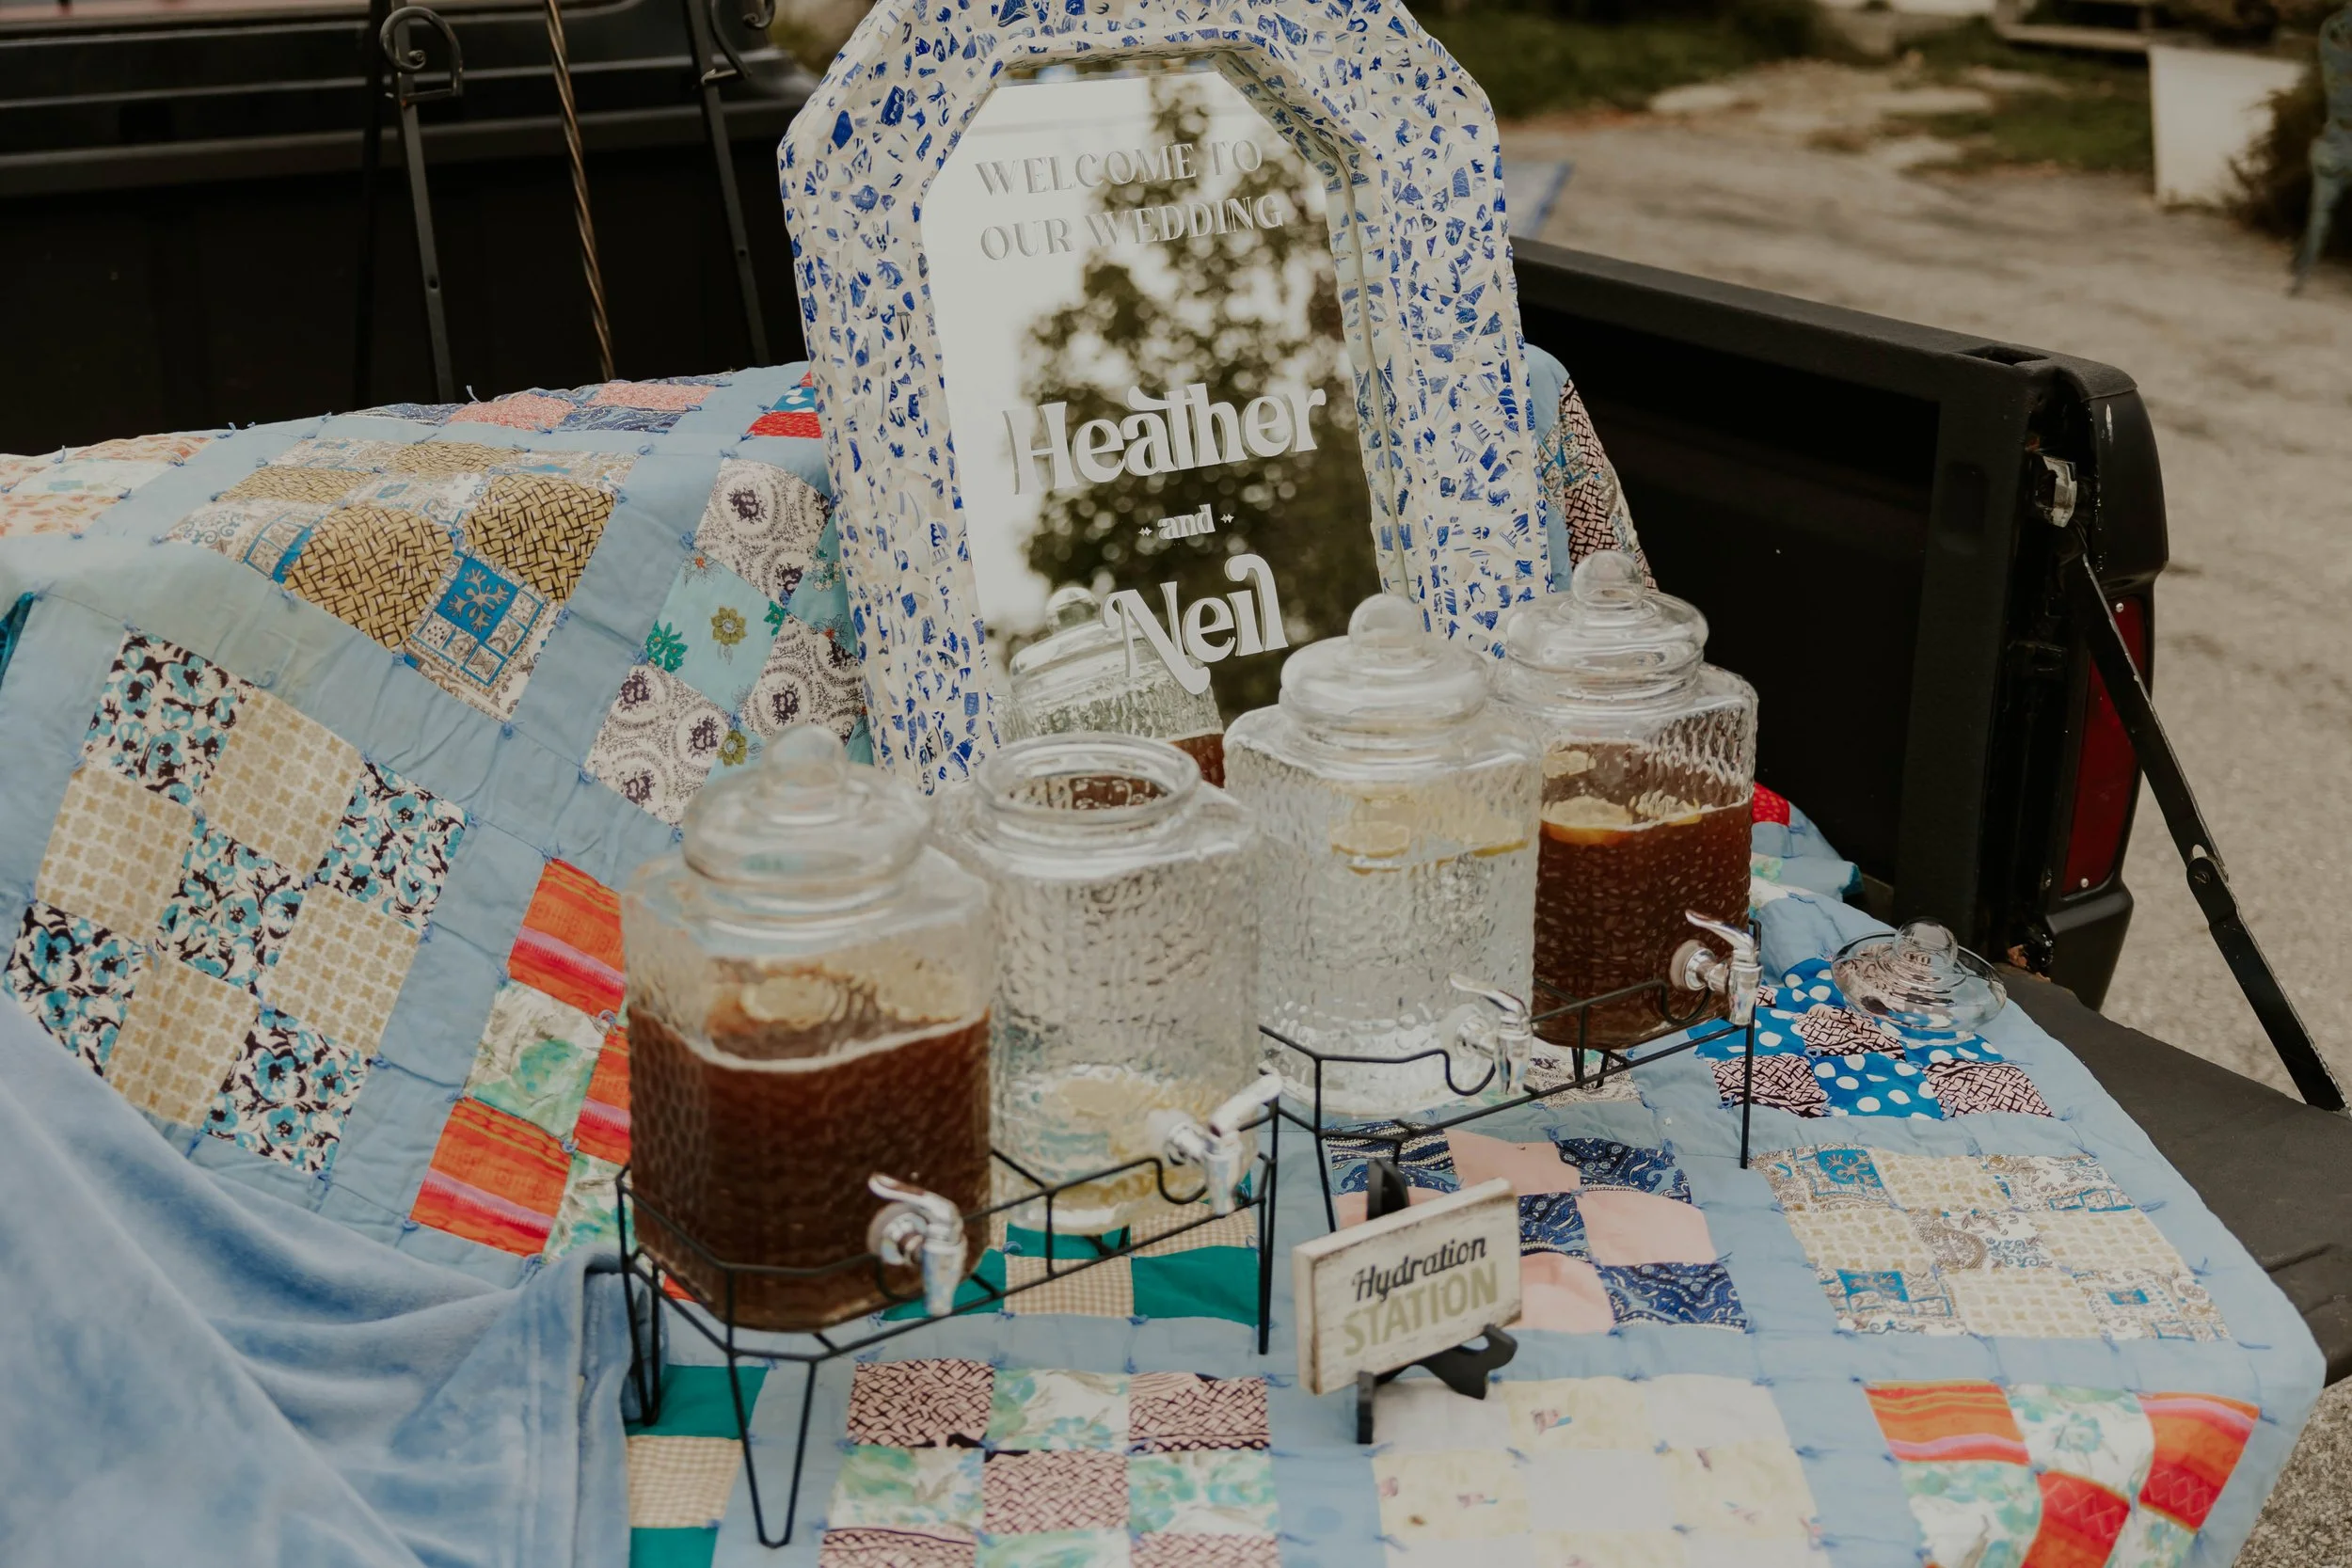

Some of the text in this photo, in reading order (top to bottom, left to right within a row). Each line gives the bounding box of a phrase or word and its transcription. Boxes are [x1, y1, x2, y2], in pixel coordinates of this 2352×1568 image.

[975, 138, 1263, 197] WELCOME TO
[979, 194, 1284, 261] OUR WEDDING
[1002, 382, 1327, 495] Heather
[1157, 503, 1216, 540] and
[1101, 553, 1289, 695] Neil
[1352, 1237, 1486, 1303] Hydration
[1343, 1261, 1499, 1357] STATION
